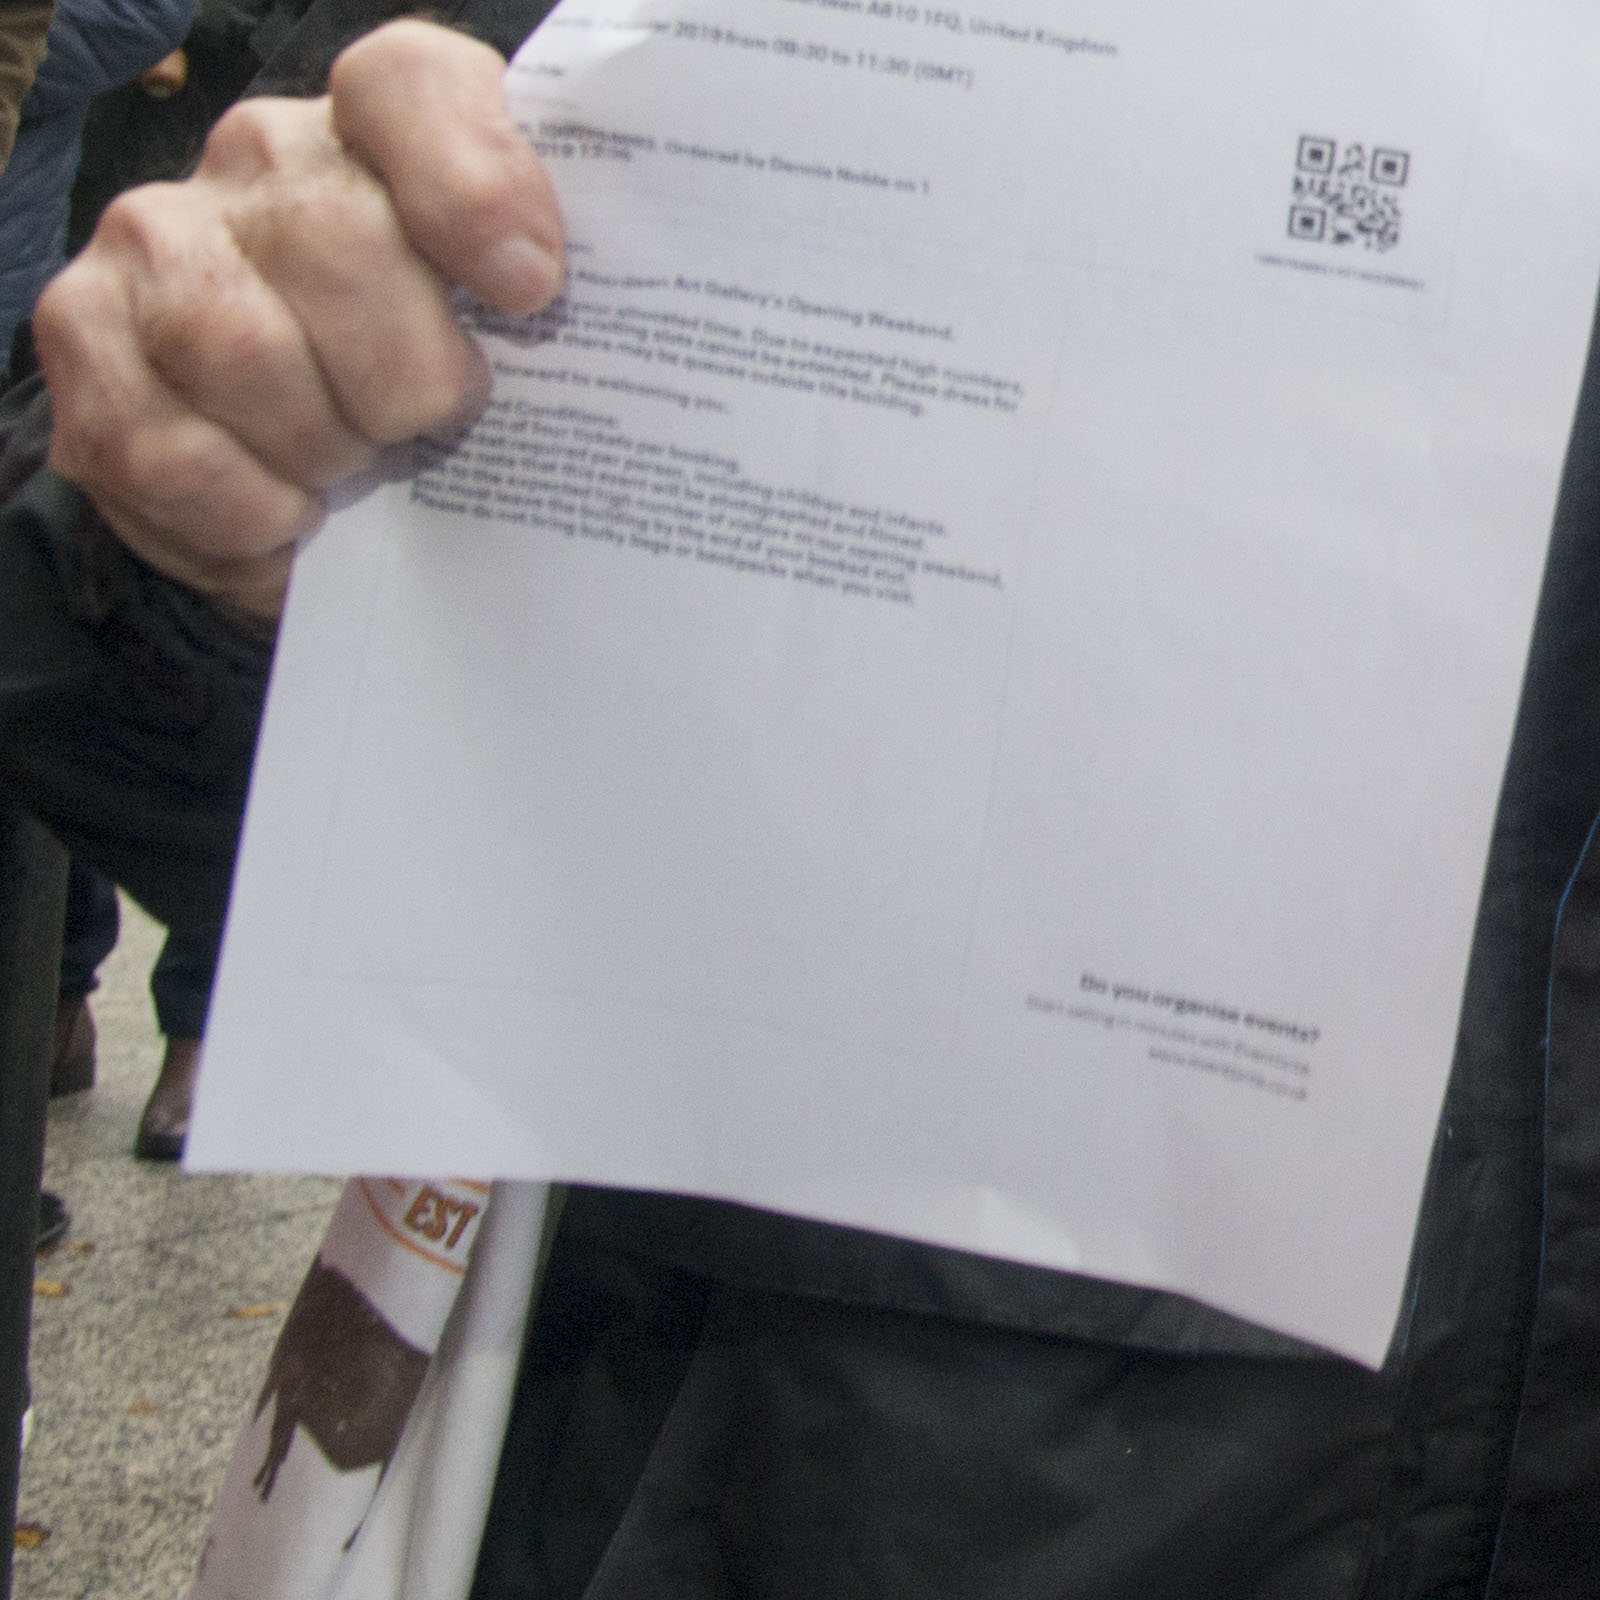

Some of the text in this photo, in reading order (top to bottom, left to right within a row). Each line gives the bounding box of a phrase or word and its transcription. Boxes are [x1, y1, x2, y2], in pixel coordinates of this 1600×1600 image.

[868, 0, 918, 23] AB10
[970, 19, 1030, 42] United
[1035, 28, 1118, 55] Kingdom
[1112, 983, 1150, 1005] you
[404, 1186, 479, 1249] EST
